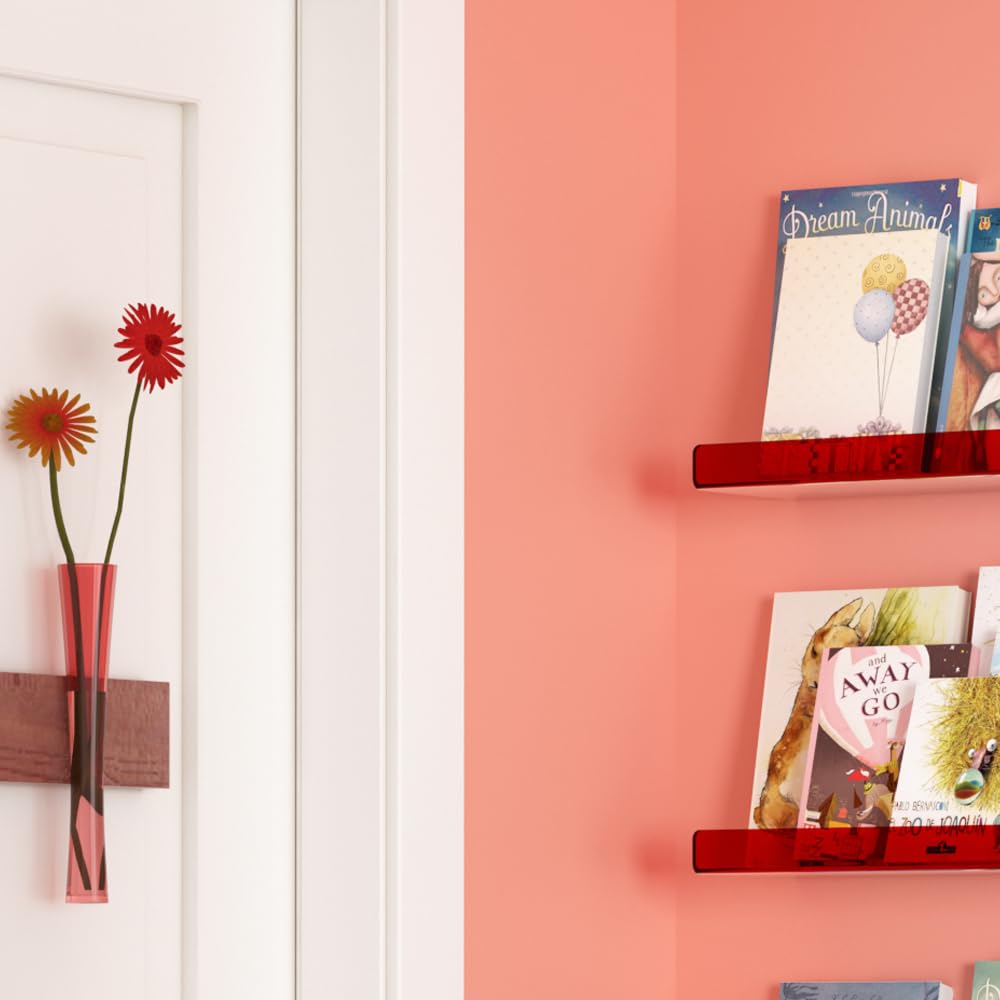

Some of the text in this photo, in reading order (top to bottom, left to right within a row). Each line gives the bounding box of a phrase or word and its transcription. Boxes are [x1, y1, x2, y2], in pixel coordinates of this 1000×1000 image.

[783, 204, 859, 239] Dream
[868, 653, 887, 667] and
[840, 662, 917, 699] AWAY
[873, 686, 887, 695] we
[861, 692, 900, 716] GO
